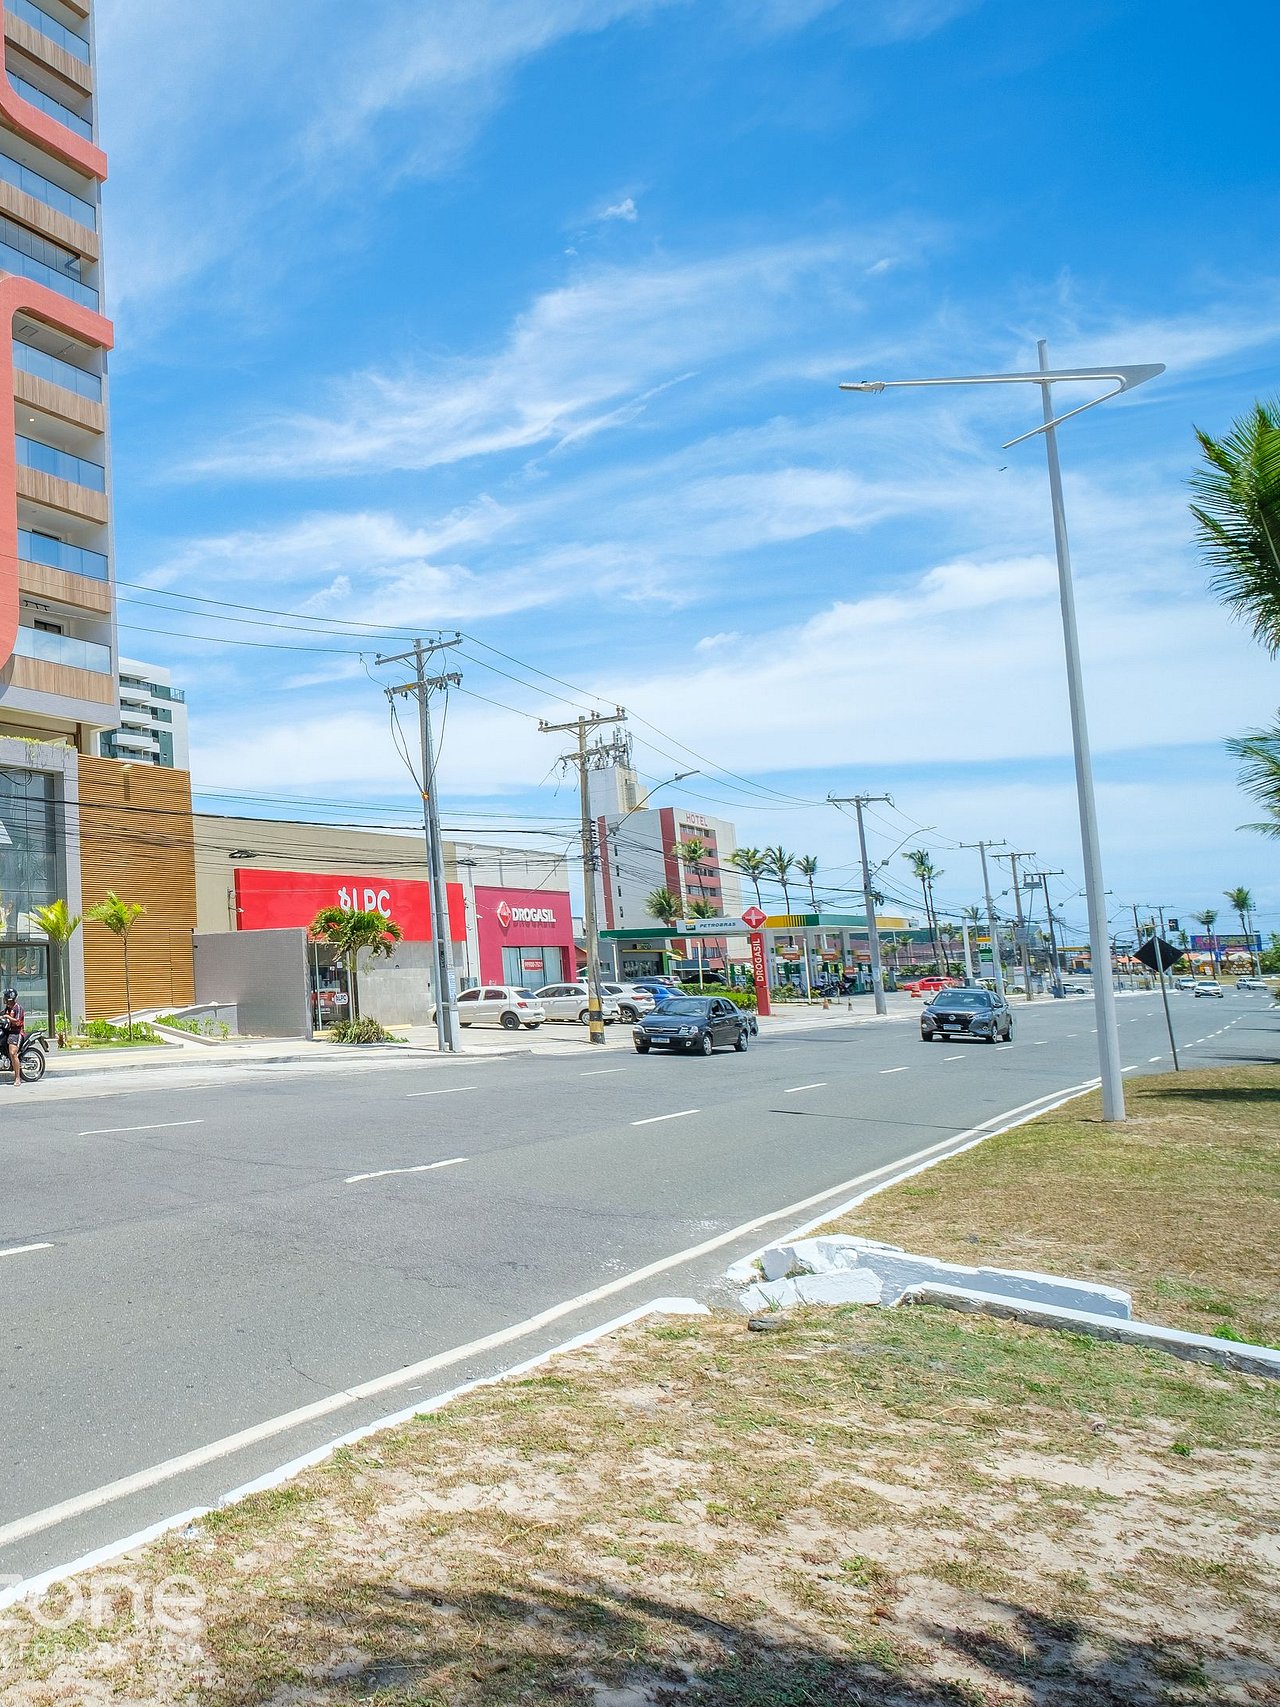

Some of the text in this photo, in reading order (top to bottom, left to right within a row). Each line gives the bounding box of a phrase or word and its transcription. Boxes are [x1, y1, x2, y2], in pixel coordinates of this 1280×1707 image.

[685, 812, 709, 828] HOTEL
[511, 907, 557, 923] DROGASIL
[752, 938, 765, 982] DROGASIL
